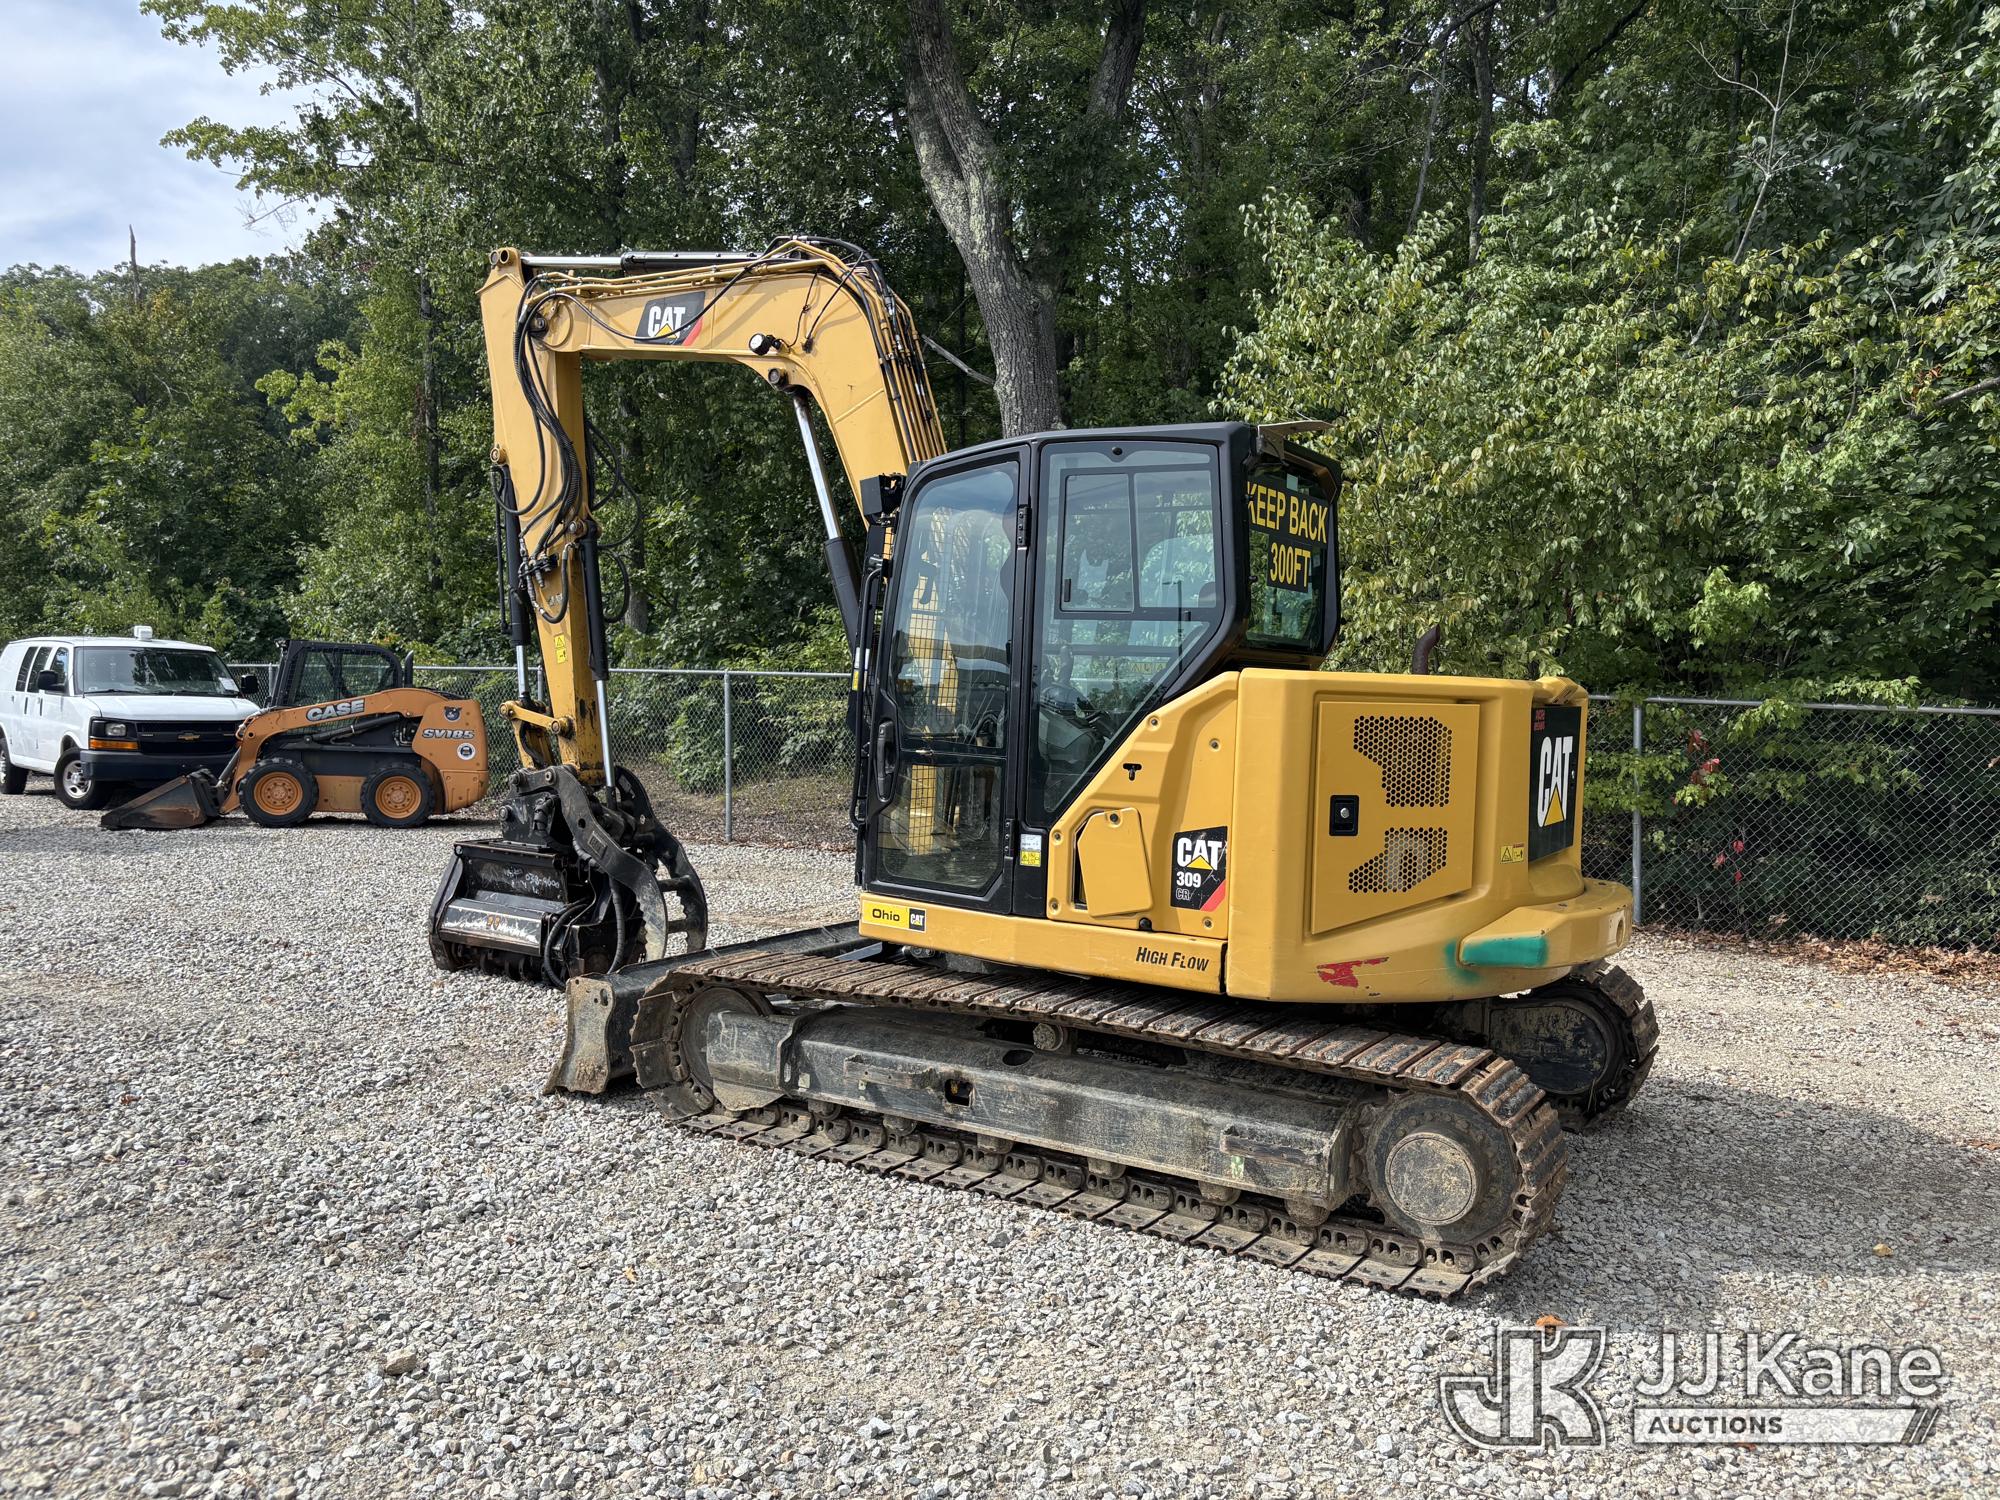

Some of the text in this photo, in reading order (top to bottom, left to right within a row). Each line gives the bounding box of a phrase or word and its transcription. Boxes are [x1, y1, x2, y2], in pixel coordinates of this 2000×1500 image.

[647, 305, 686, 339] CAT
[1247, 481, 1328, 544] KEEP BACK
[1270, 542, 1311, 587] 300FT
[306, 698, 365, 722] CASE
[422, 728, 475, 739] SV185
[1537, 736, 1573, 828] CAT
[1177, 837, 1223, 870] CAT
[1176, 871, 1201, 888] 309
[1176, 887, 1190, 900] CR
[872, 908, 924, 926] Ohio CAT
[1136, 946, 1168, 966] HIGH
